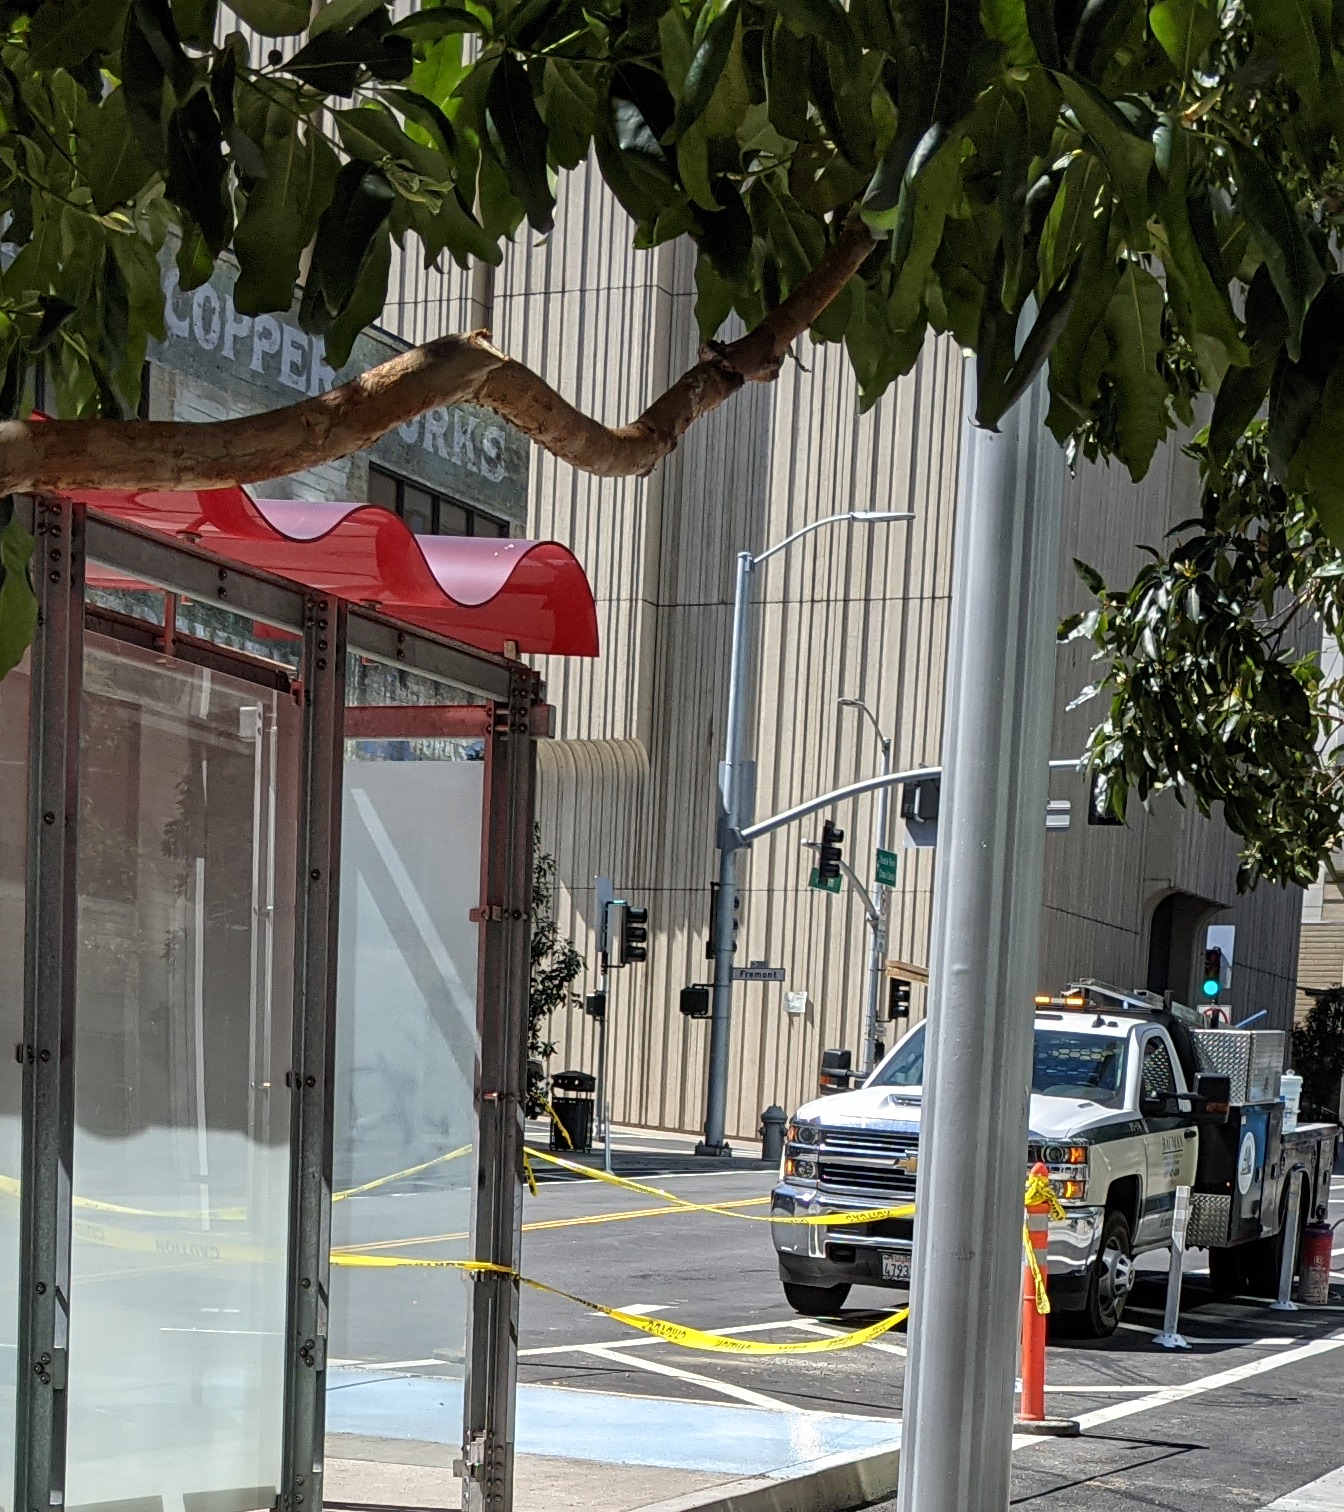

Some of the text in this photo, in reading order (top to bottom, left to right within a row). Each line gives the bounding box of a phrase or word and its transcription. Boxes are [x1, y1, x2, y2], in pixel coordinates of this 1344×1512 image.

[397, 404, 508, 482] ORKS
[740, 970, 777, 979] Fremont
[884, 1262, 911, 1279] 4793
